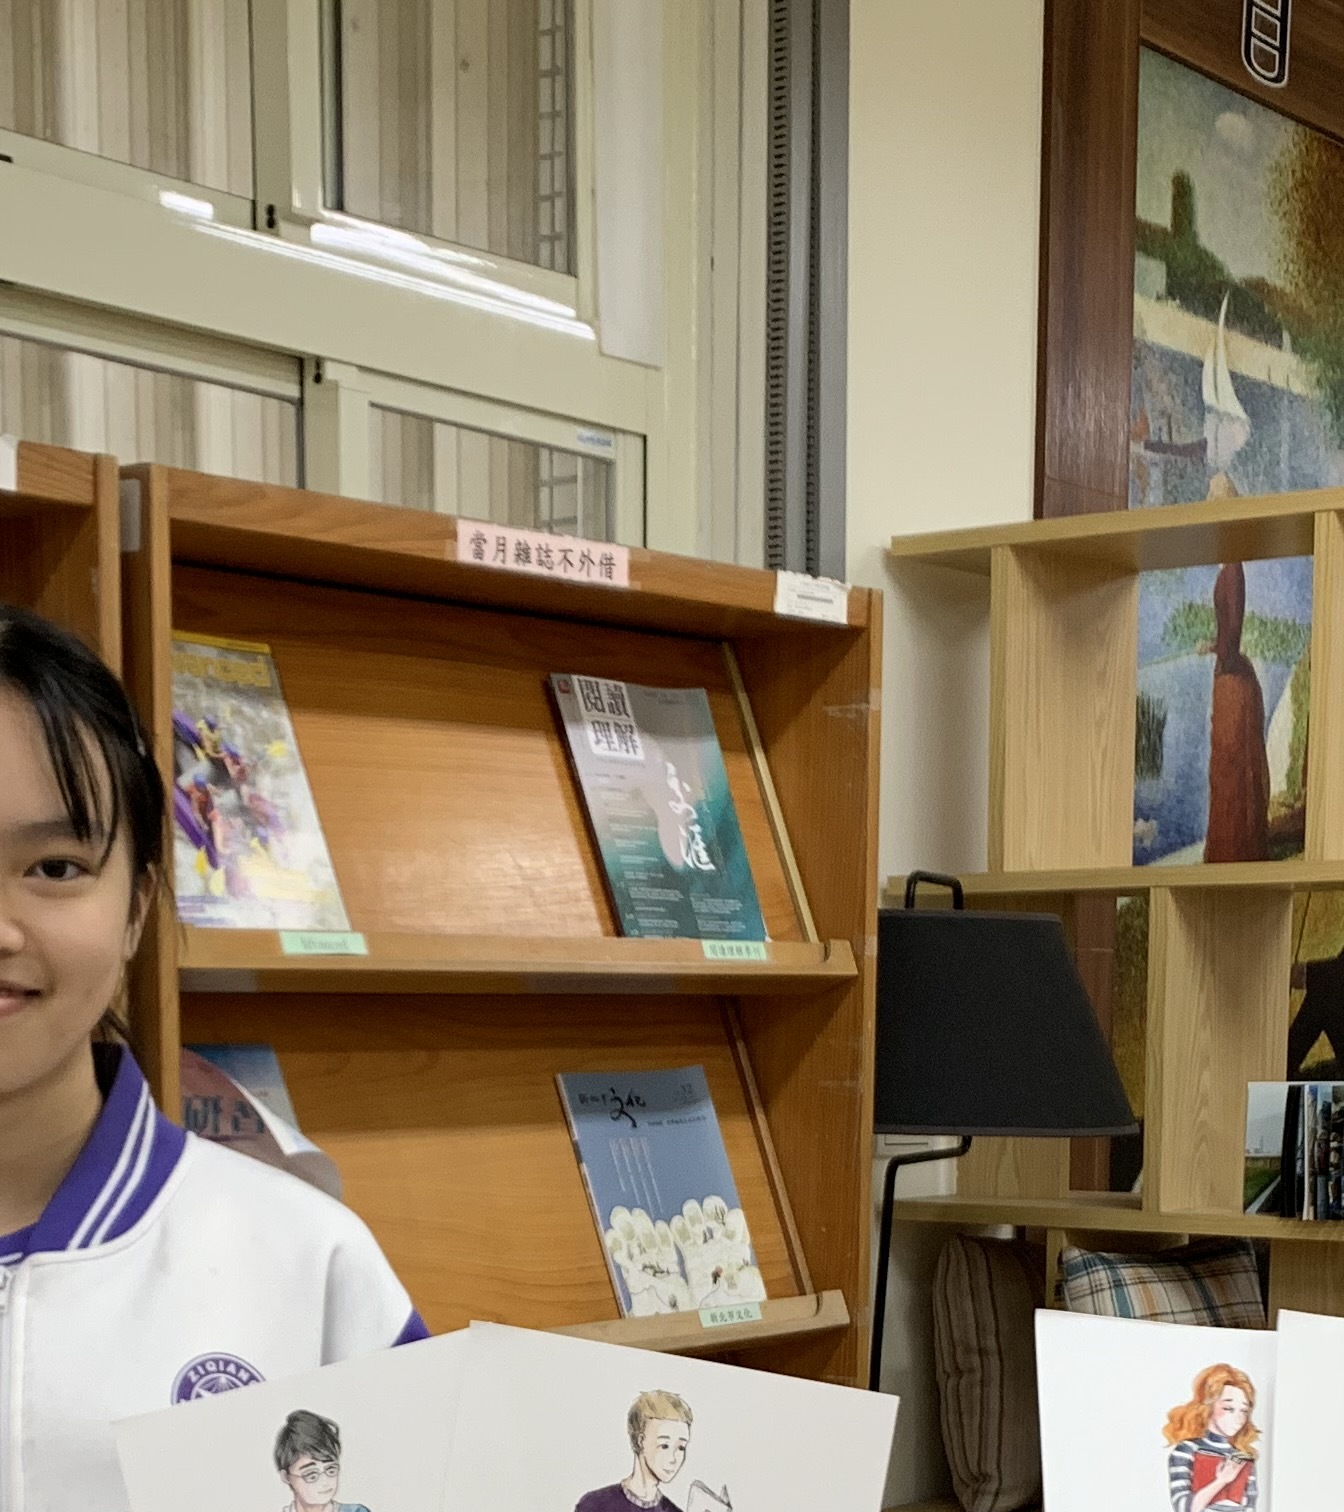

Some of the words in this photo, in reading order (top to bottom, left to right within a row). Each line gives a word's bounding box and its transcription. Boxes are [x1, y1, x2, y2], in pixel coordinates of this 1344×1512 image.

[468, 529, 617, 581] 當月雜誌不外借
[577, 677, 630, 719] 閱讀
[592, 719, 639, 756] 理解
